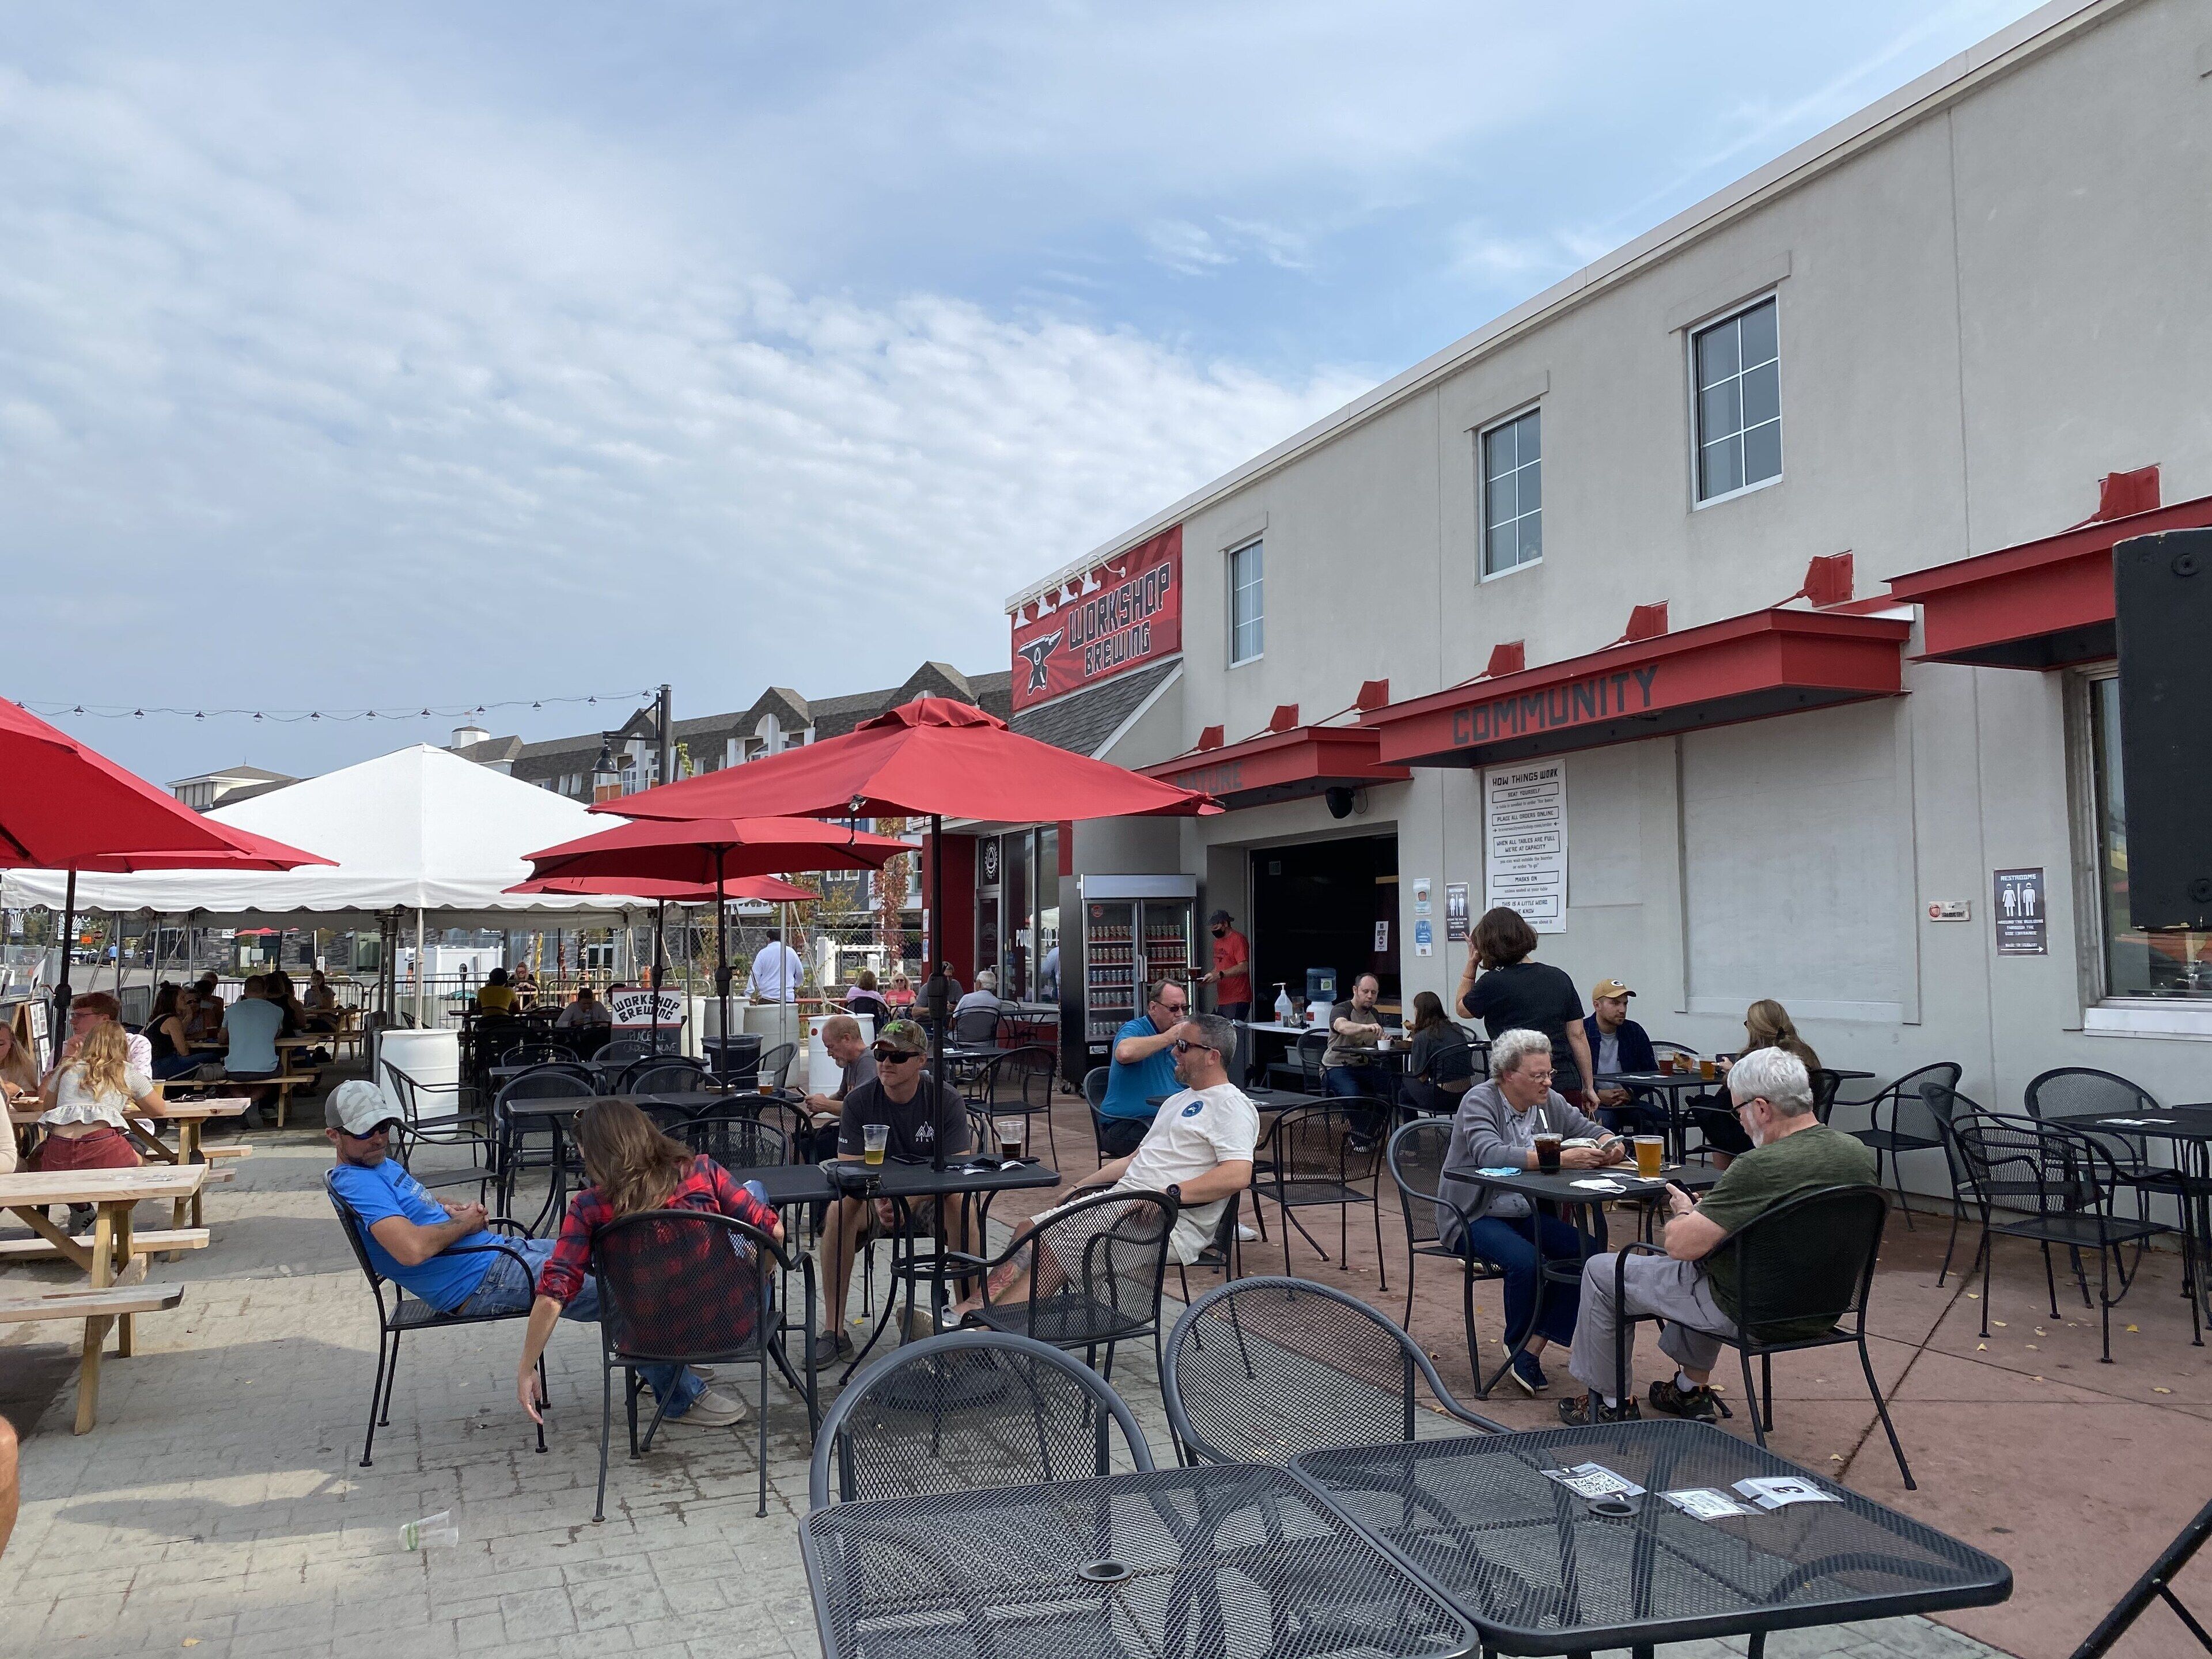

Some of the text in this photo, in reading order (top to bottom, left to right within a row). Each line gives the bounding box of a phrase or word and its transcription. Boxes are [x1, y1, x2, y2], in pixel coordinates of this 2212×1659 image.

[1069, 562, 1171, 652] WORKSHOP
[1085, 620, 1152, 678] BREWING
[1453, 664, 1659, 745] COMMUNITY
[1493, 768, 1558, 786] HOW THINGS WORK
[612, 994, 680, 1013] WORKSHOP
[618, 1005, 674, 1023] BREWNG
[628, 1030, 652, 1041] PLACE
